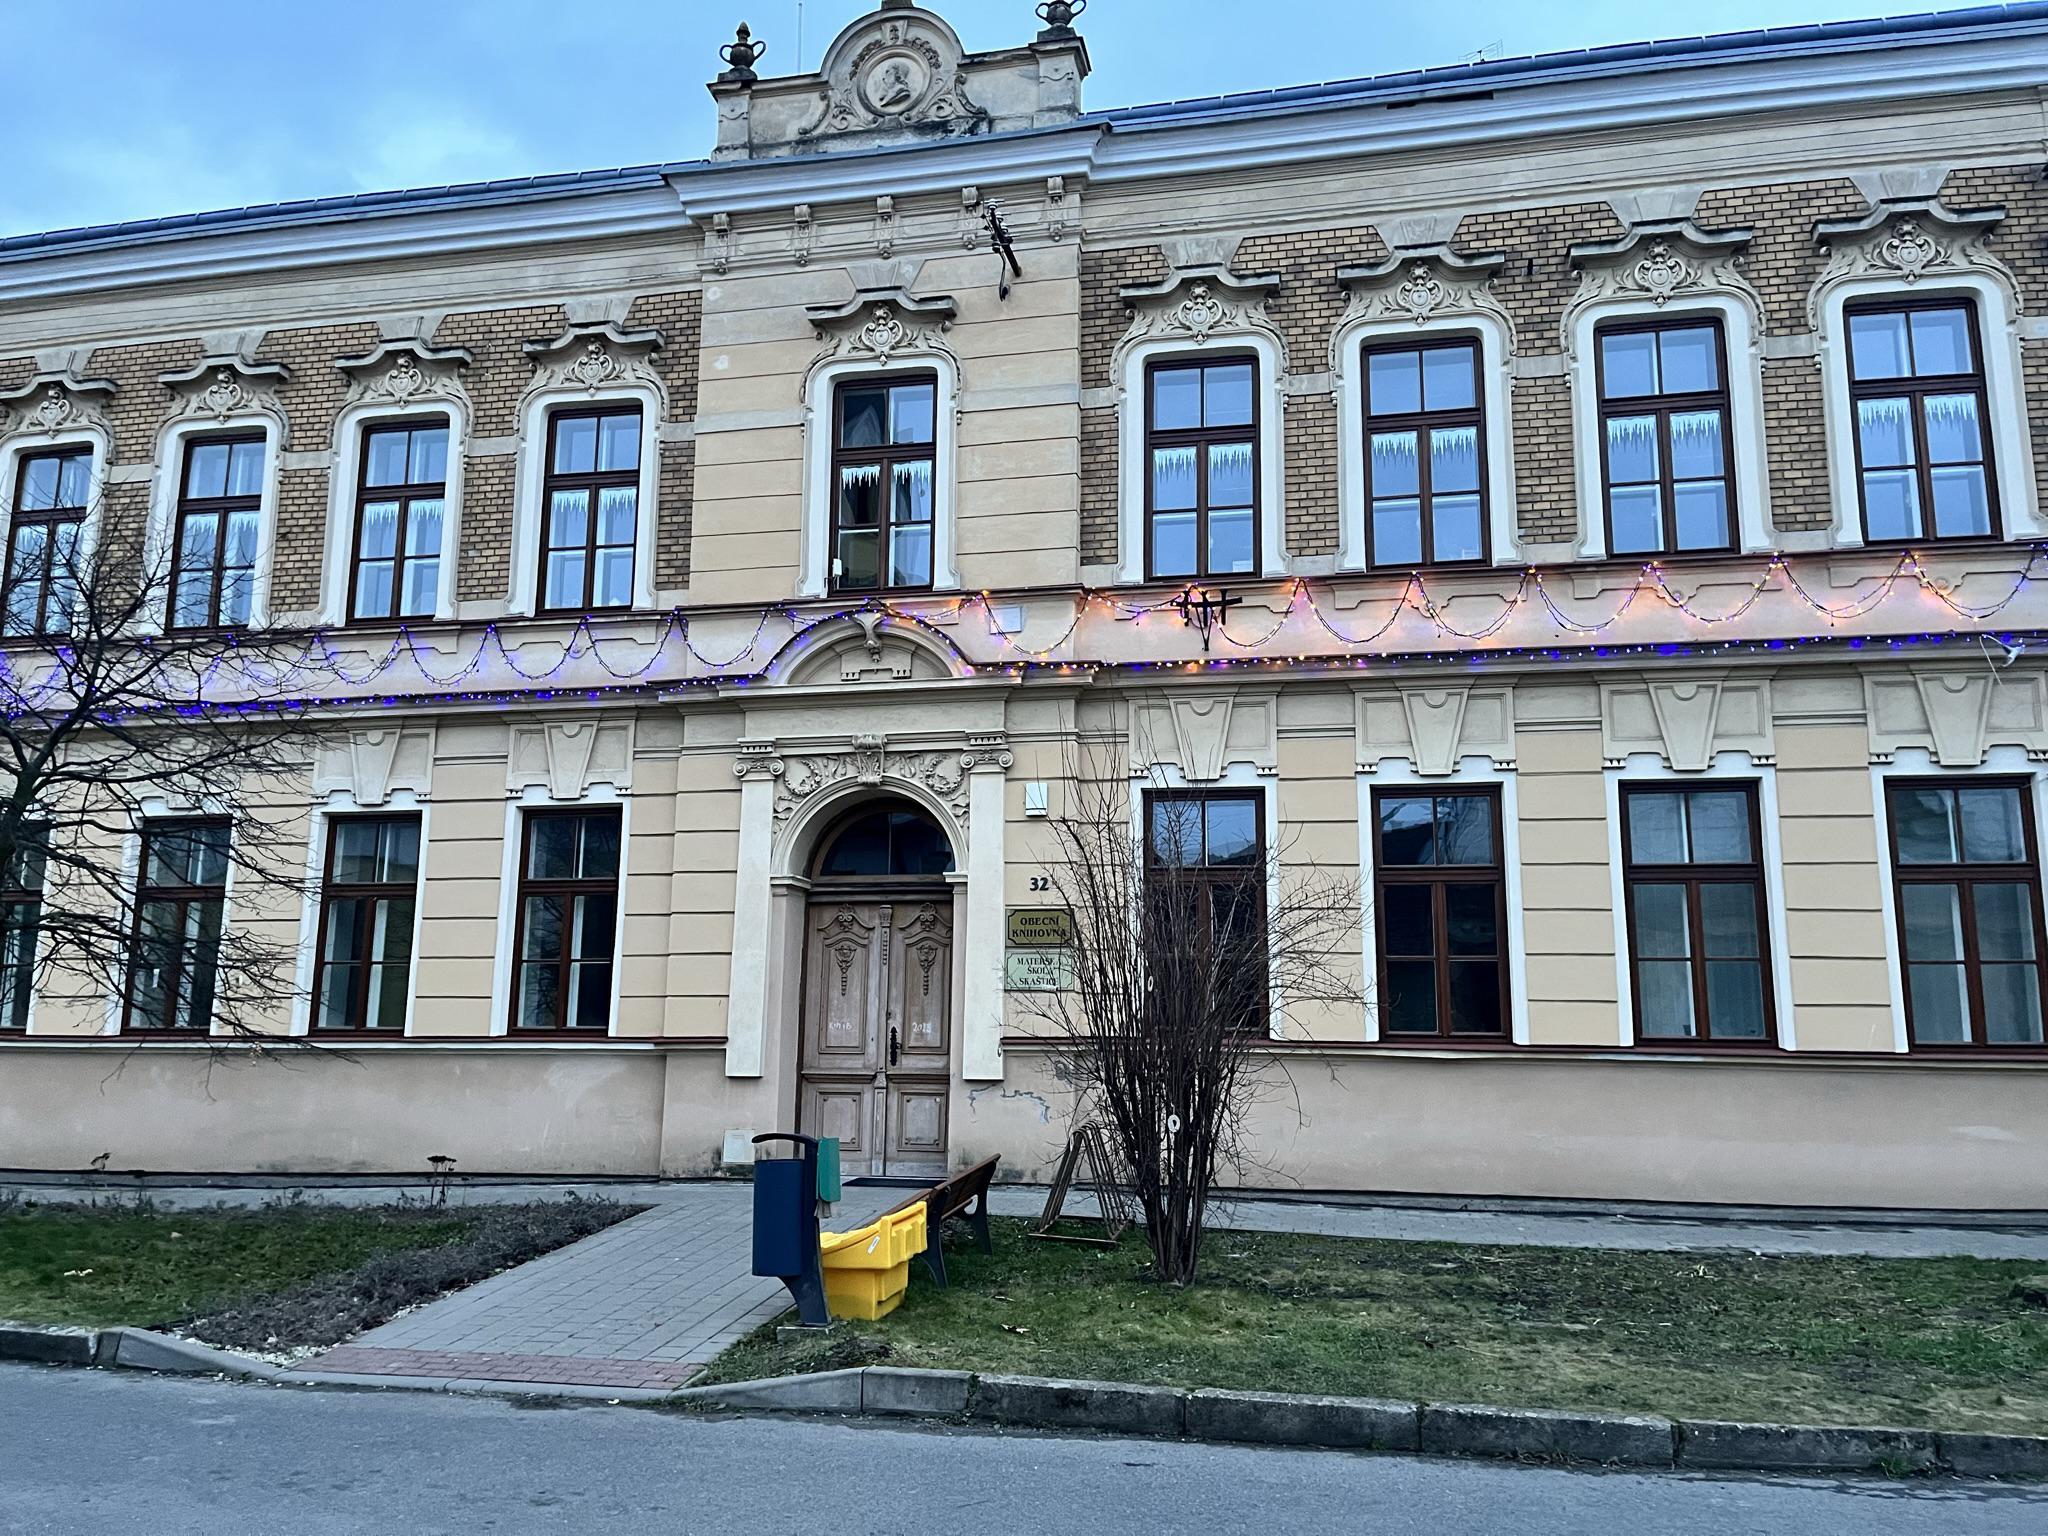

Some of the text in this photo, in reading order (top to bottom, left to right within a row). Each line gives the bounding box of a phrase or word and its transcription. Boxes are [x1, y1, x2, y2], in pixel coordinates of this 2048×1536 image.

[1029, 877, 1049, 891] 32
[1020, 915, 1060, 926] OBECNÍ
[1012, 928, 1066, 938] KNIHOVNA
[1019, 976, 1059, 986] SKAŠTIC
